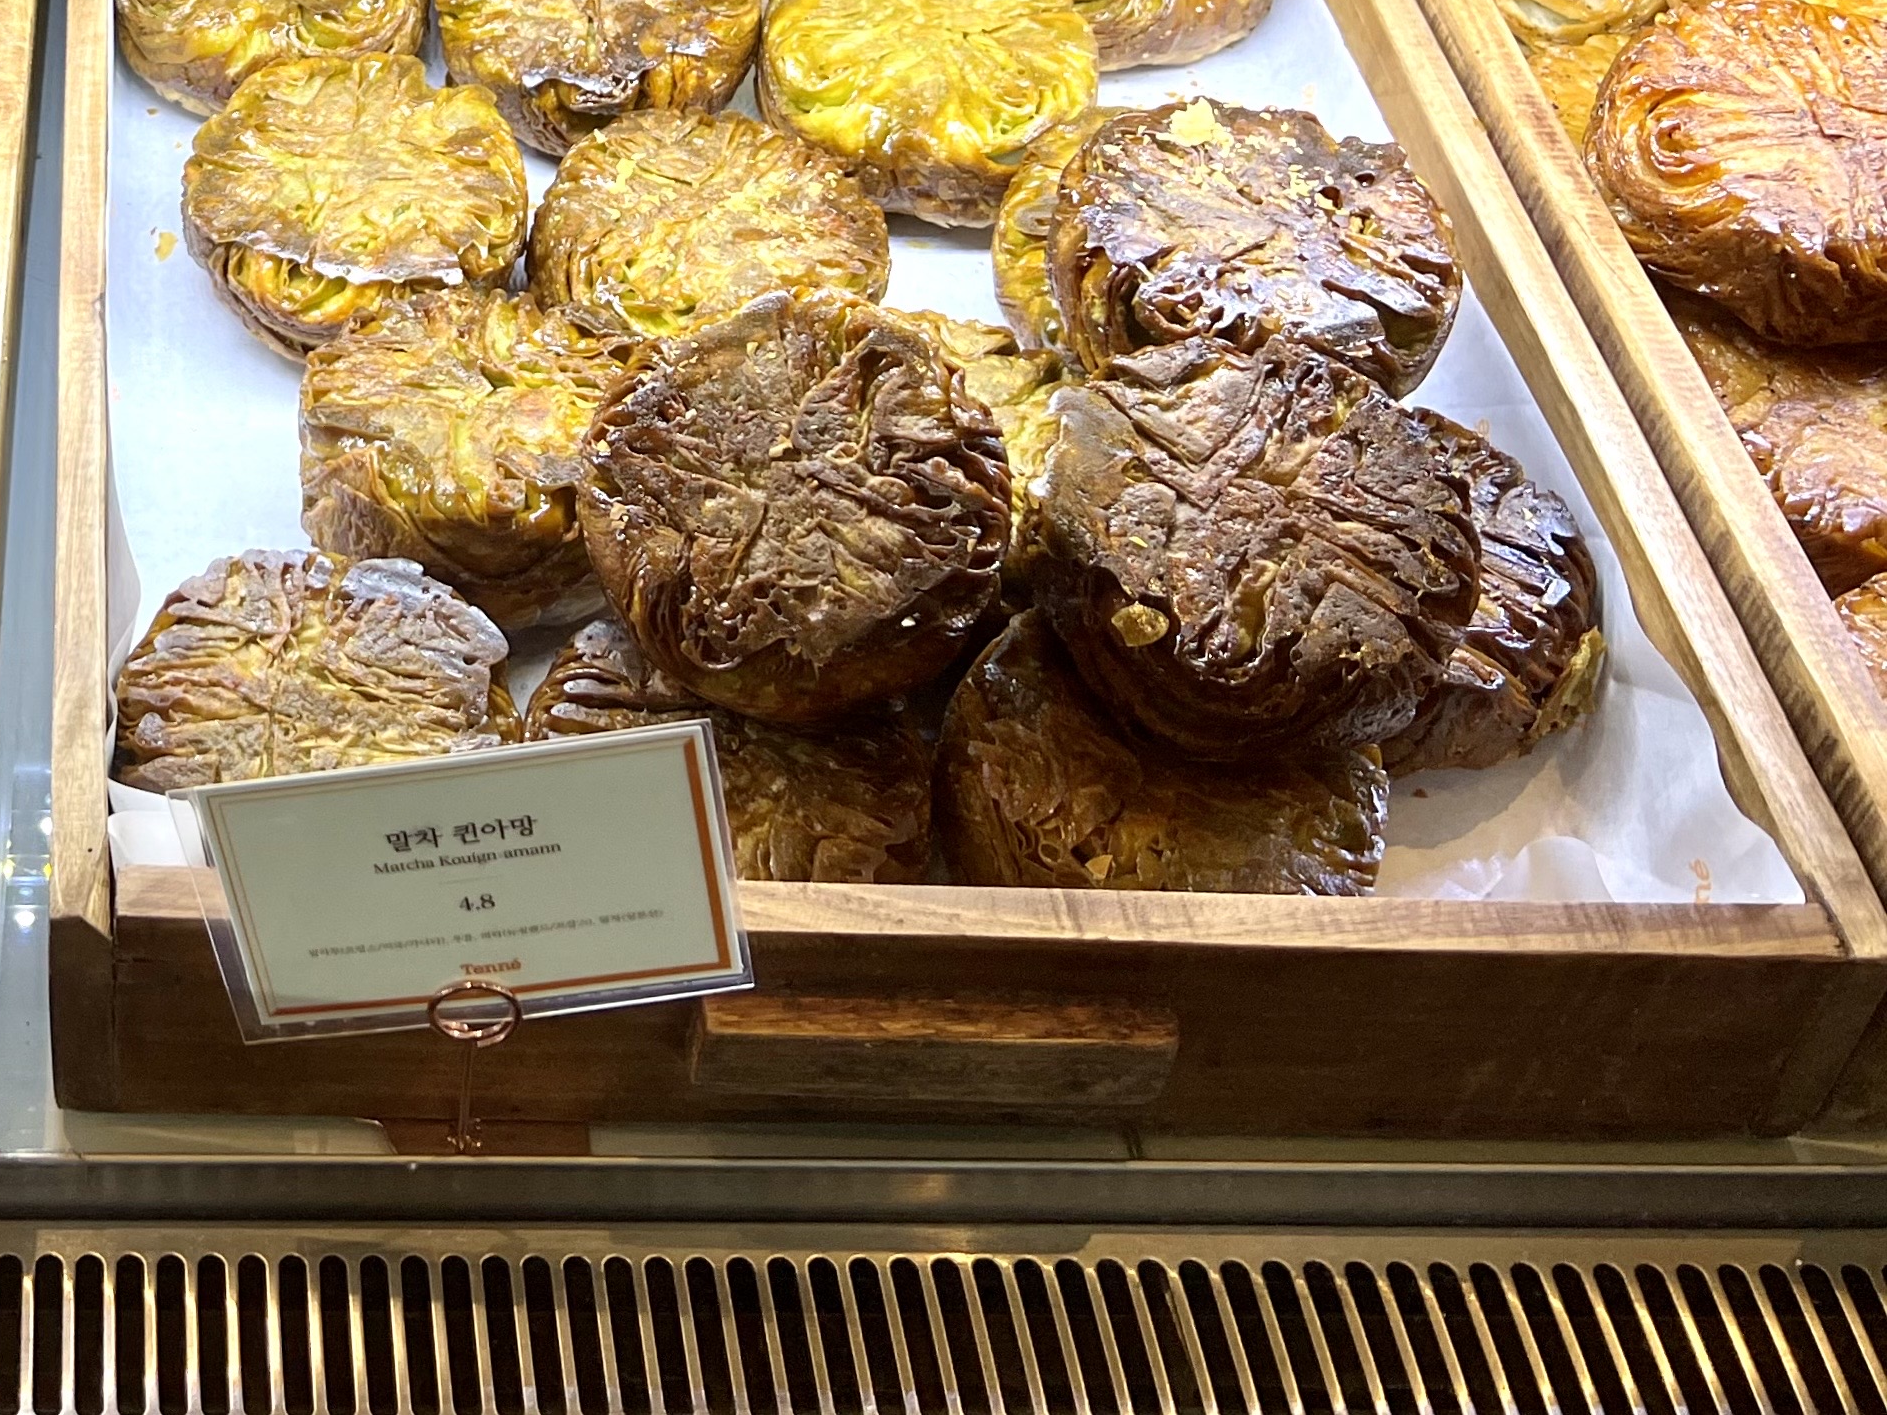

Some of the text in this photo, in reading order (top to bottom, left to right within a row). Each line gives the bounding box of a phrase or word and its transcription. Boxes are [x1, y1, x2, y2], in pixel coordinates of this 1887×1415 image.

[385, 814, 539, 853] 말차 퀸아망
[373, 857, 435, 875] Matcha
[459, 893, 496, 912] 4.8
